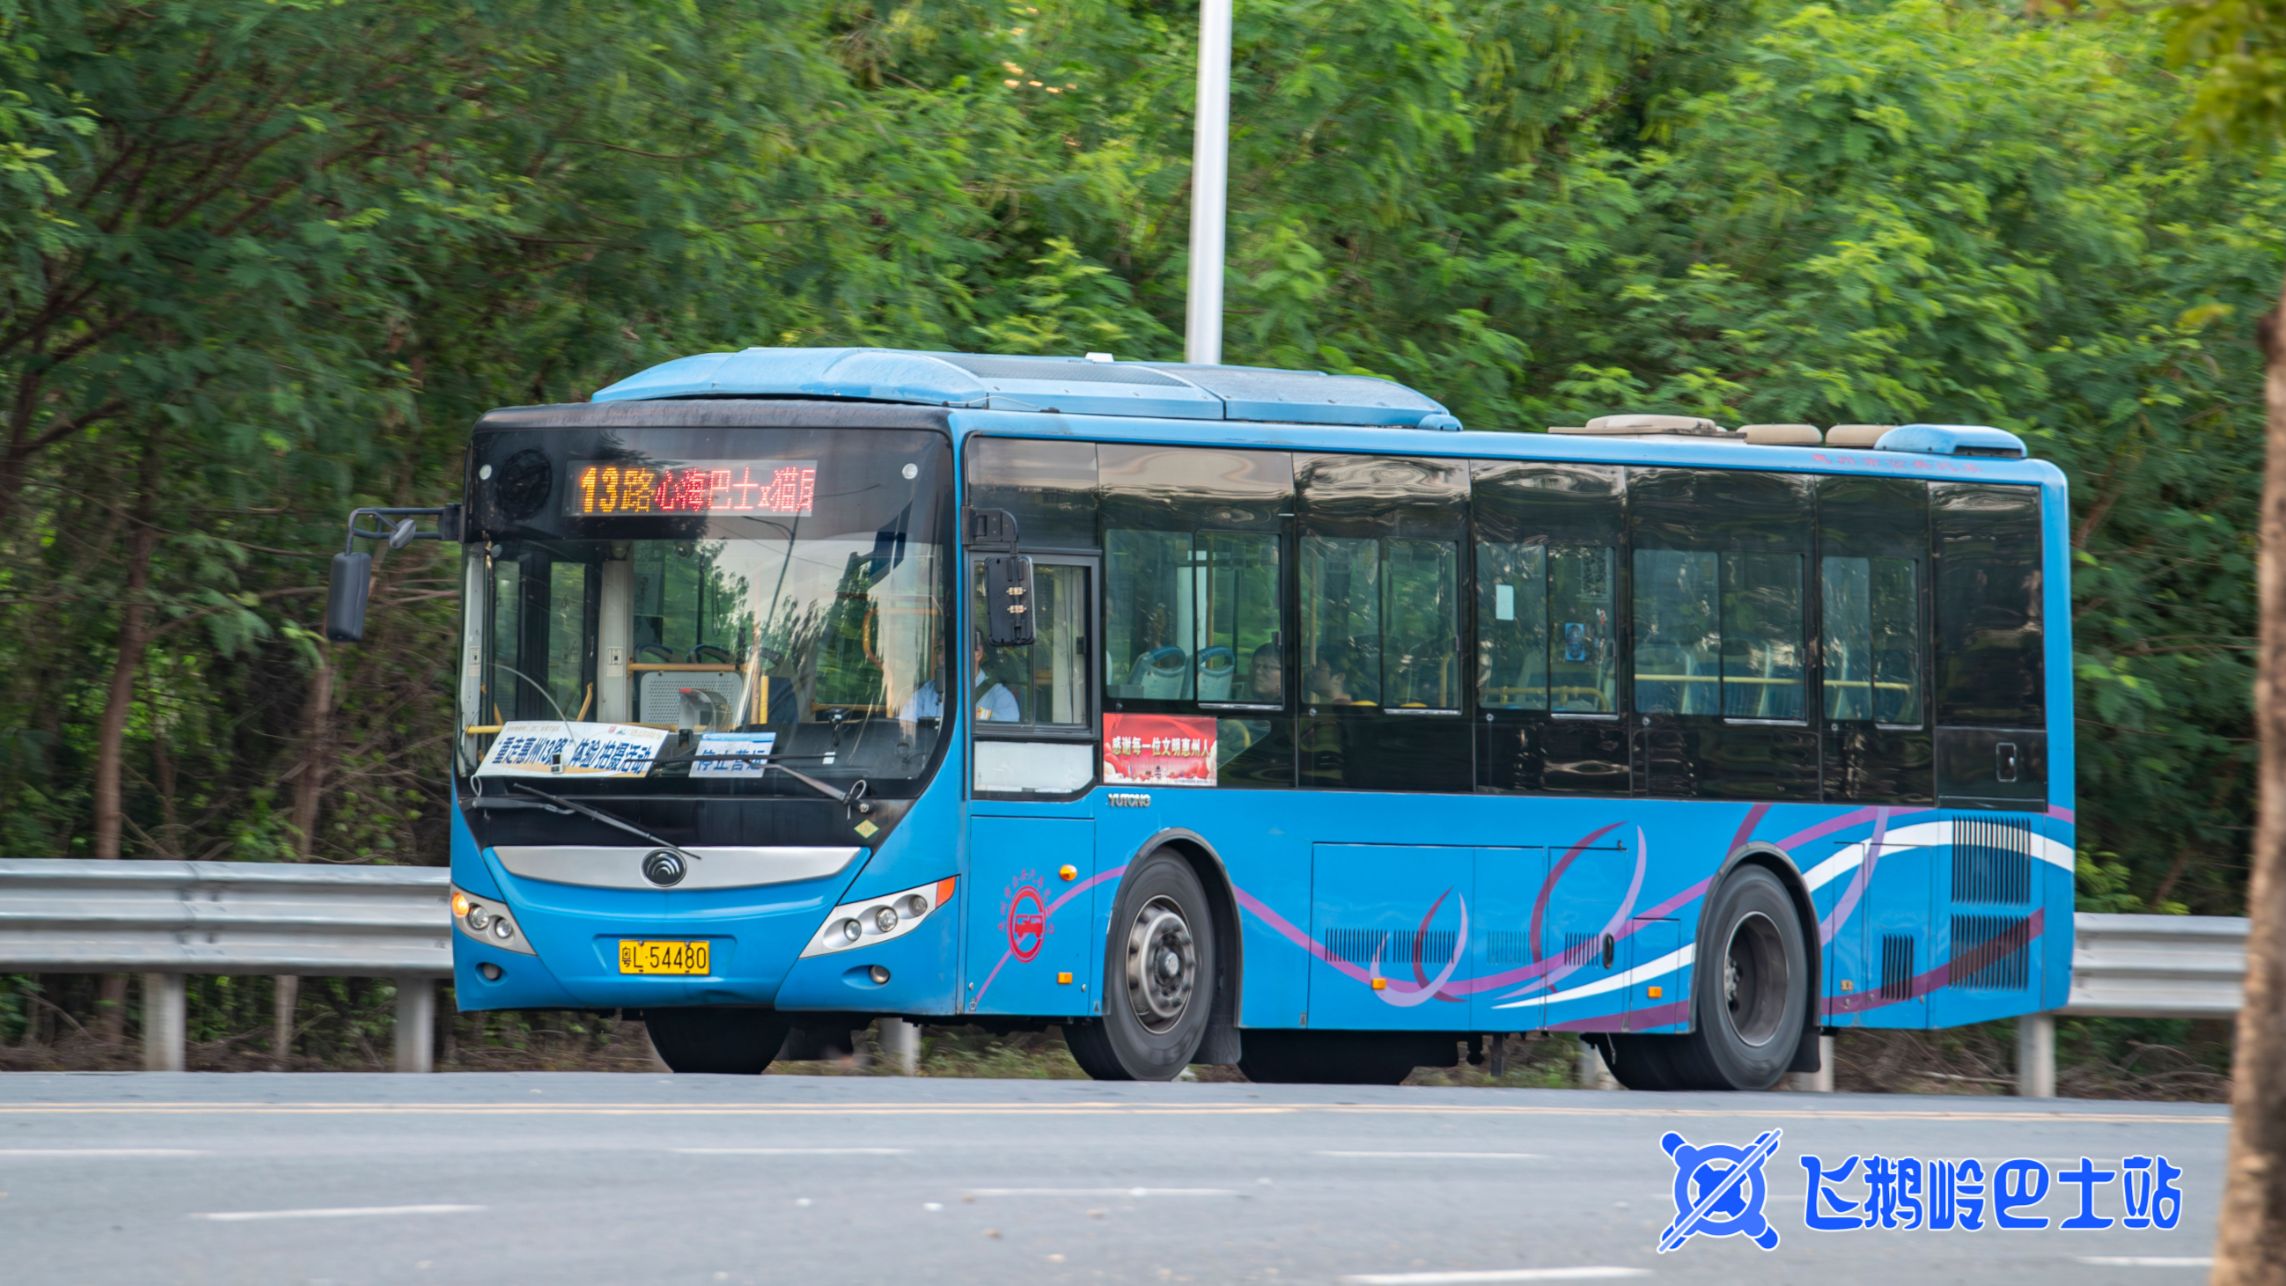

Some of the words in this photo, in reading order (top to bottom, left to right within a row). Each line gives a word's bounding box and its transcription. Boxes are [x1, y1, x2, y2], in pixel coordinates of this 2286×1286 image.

[1112, 736, 1209, 757] 感谢每一位文明惠州人
[1108, 793, 1151, 807] YUTONG
